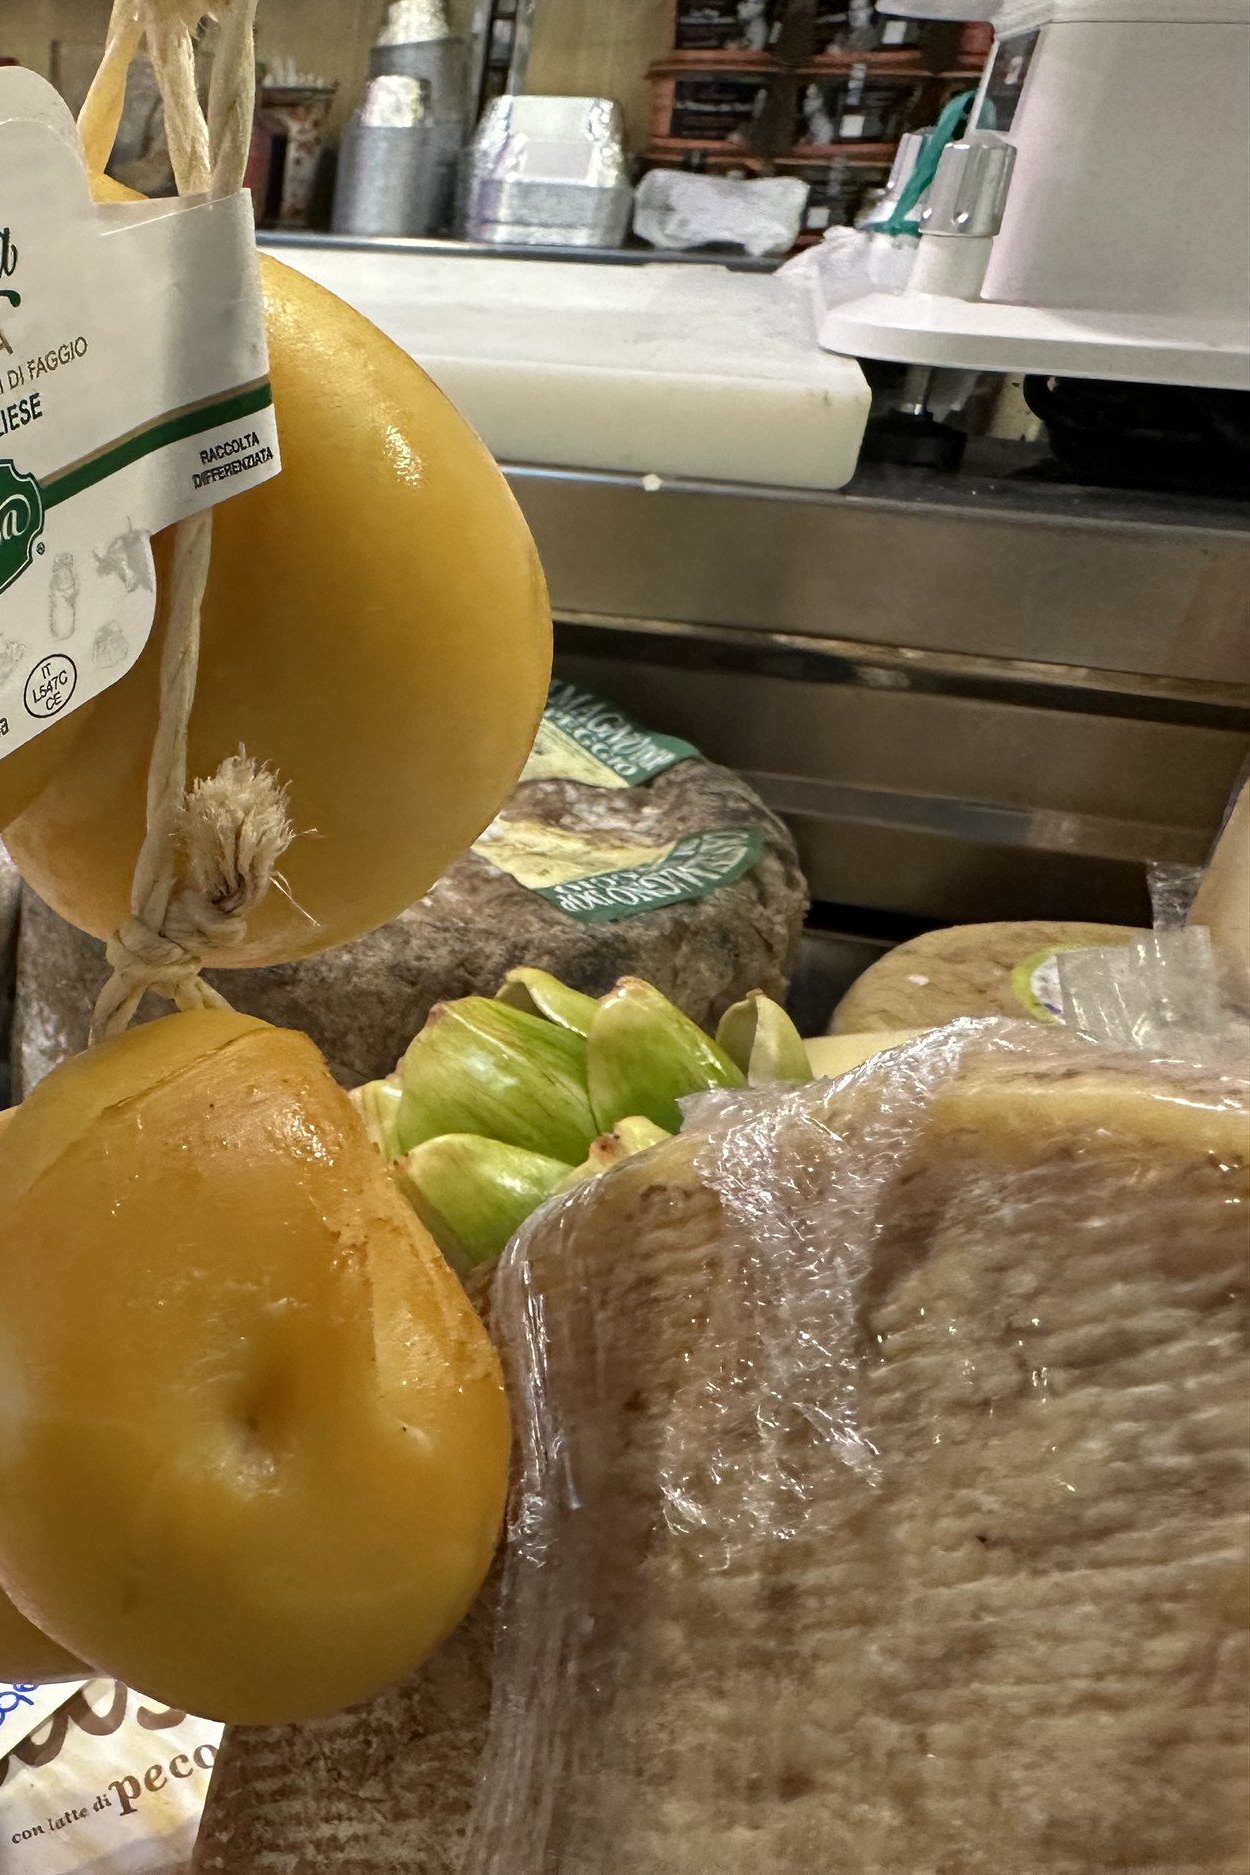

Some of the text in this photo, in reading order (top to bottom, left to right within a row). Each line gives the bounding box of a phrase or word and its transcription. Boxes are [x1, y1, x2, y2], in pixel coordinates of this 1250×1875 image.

[7, 366, 25, 393] DI
[27, 335, 88, 381] FAGGIO
[199, 432, 260, 465] RACCOLTA
[192, 447, 273, 490] DIFFERENZIATA
[41, 662, 52, 680] IT
[45, 692, 62, 711] CE
[11, 1824, 46, 1845] con
[49, 1806, 91, 1833] latte
[92, 1793, 113, 1813] di
